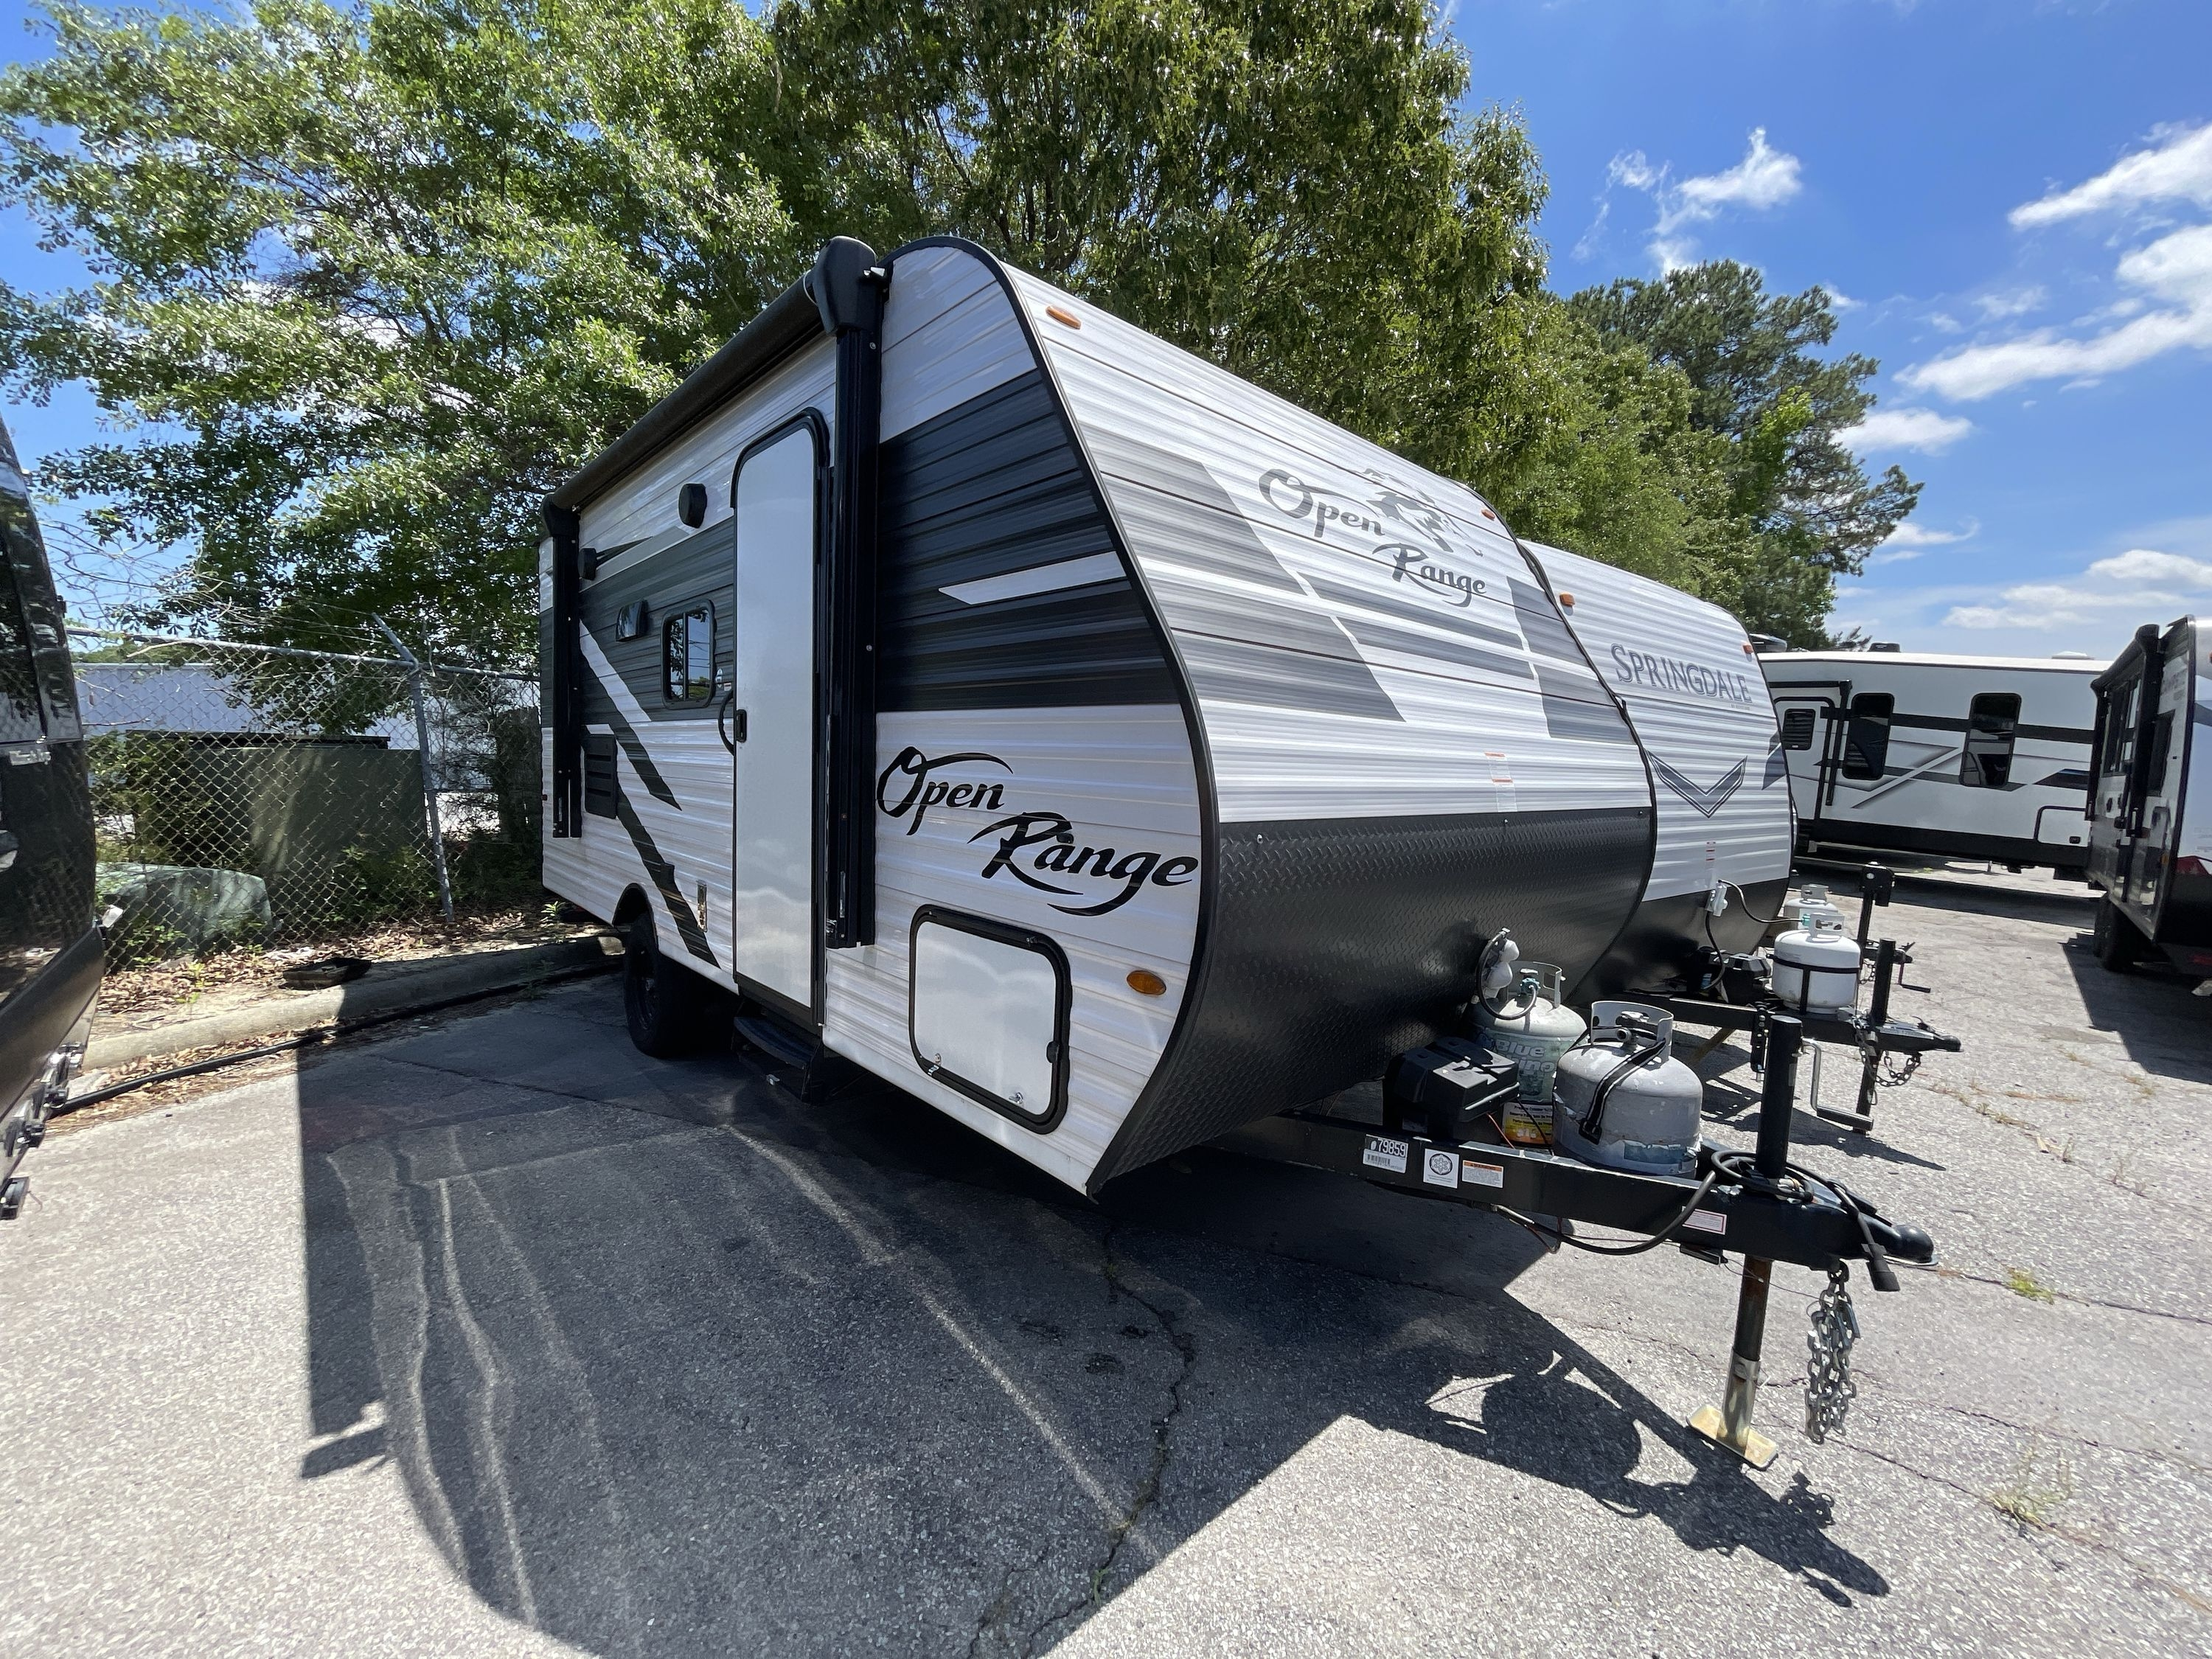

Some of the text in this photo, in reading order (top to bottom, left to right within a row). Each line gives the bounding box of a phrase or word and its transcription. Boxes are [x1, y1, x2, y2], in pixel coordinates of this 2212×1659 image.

[1259, 468, 1385, 538] Open
[1372, 543, 1487, 608] Range
[1610, 643, 1753, 703] SPRINGDALE
[877, 746, 1013, 835] Open
[967, 811, 1199, 917] Range
[1495, 1039, 1545, 1057] Blue
[1377, 1138, 1406, 1158] 79859
